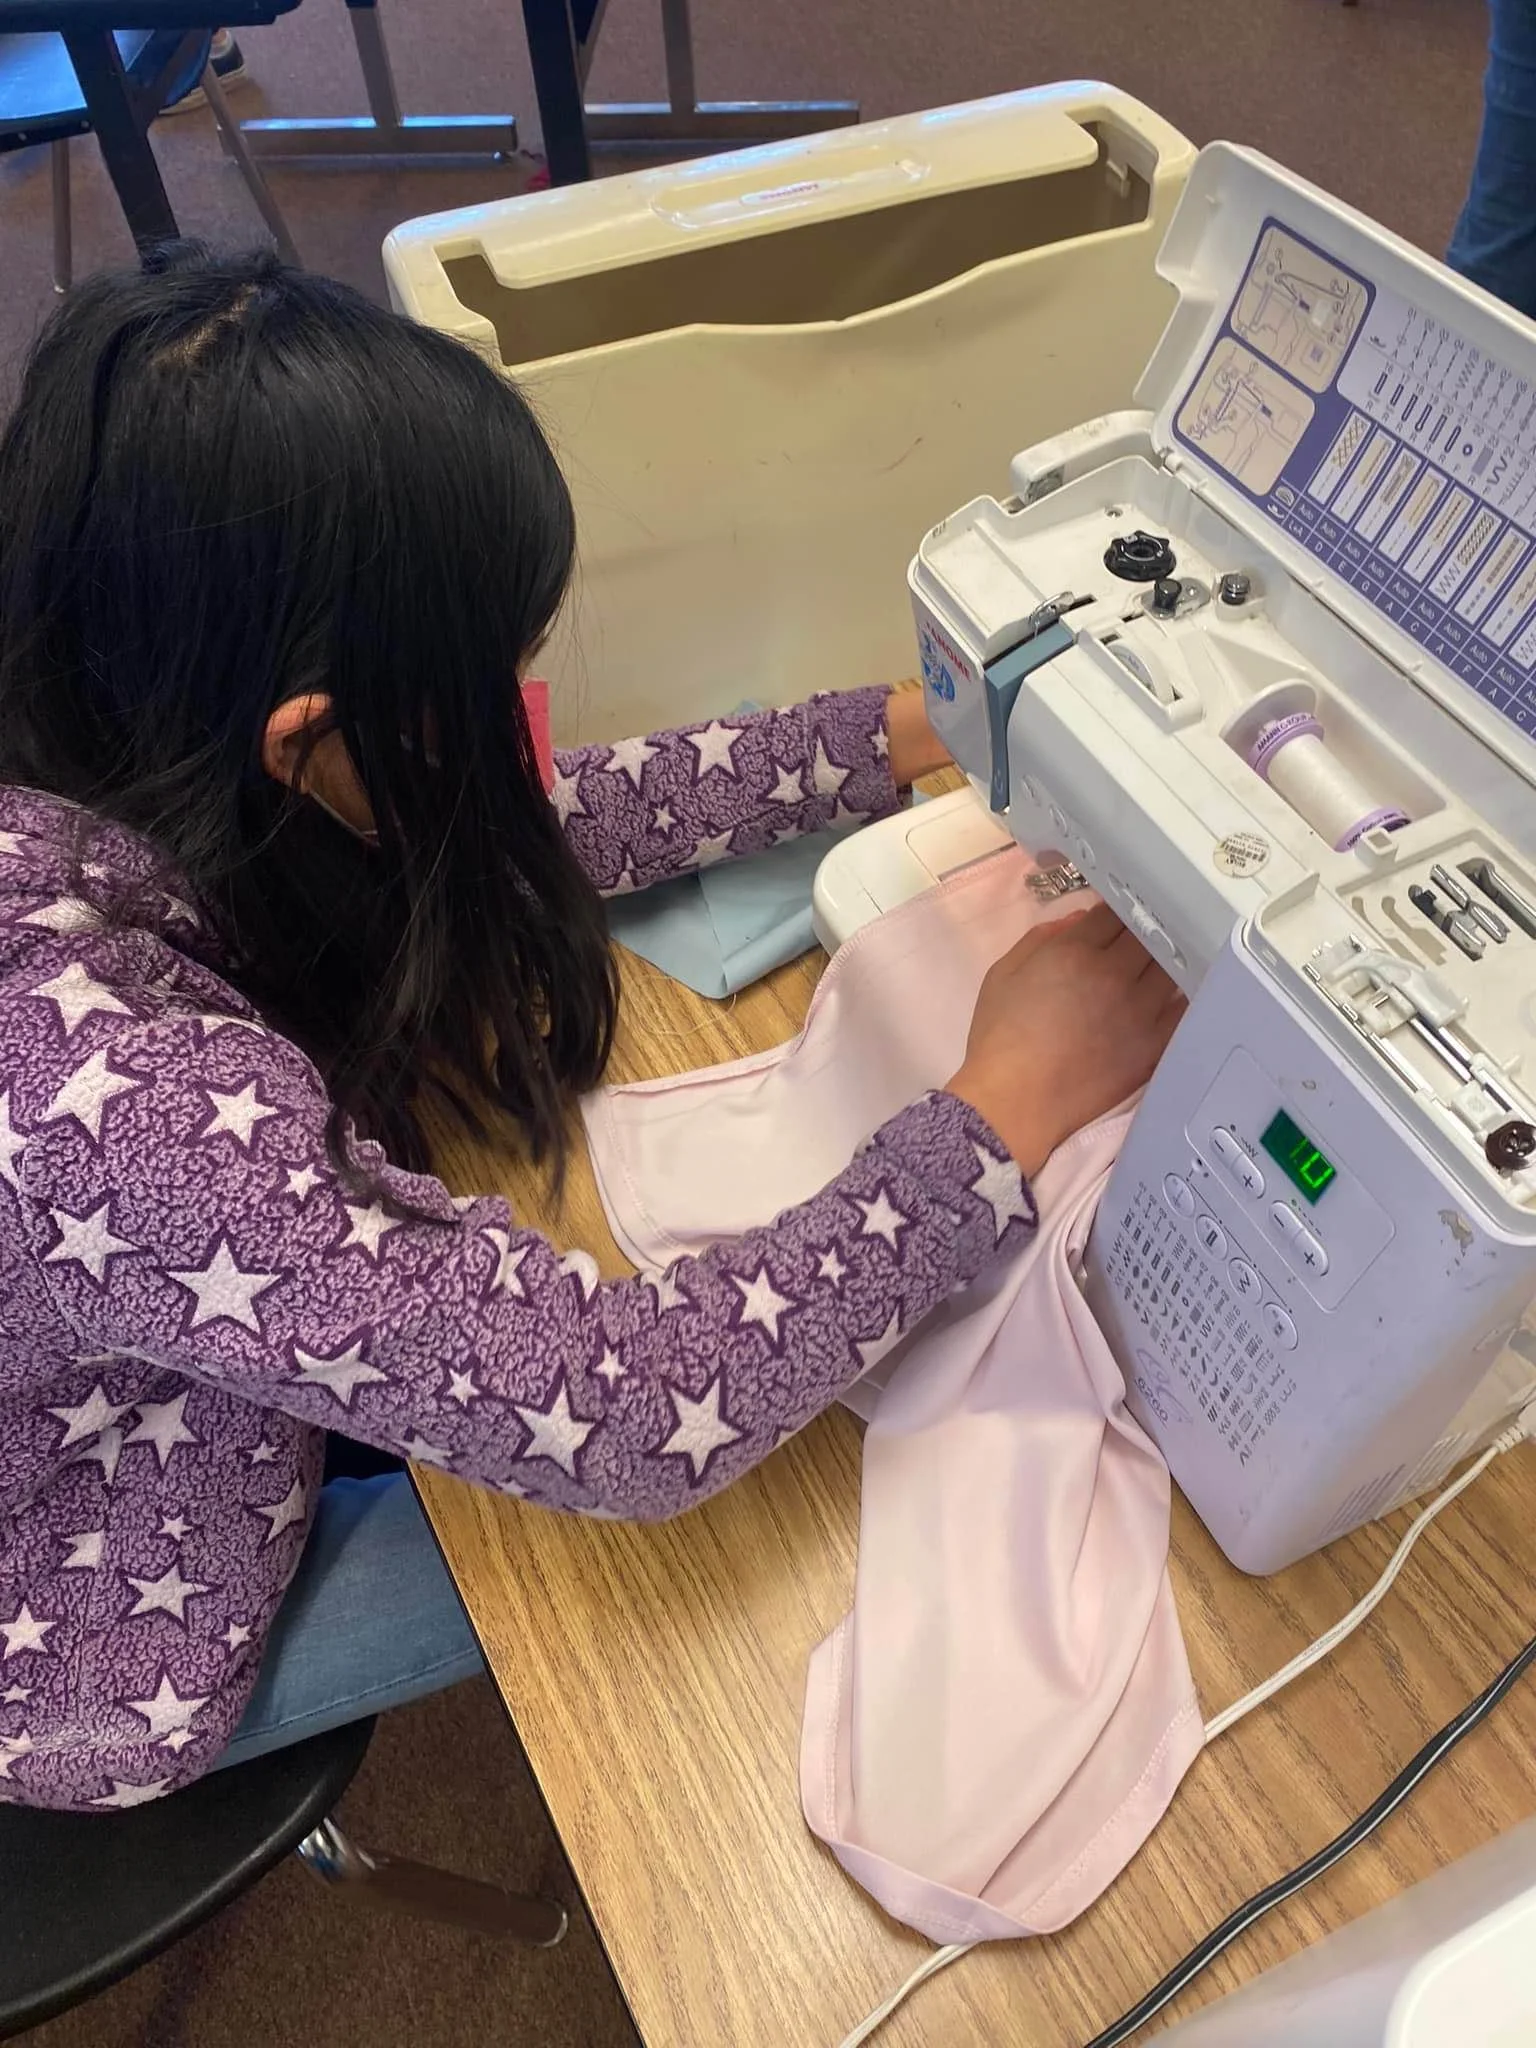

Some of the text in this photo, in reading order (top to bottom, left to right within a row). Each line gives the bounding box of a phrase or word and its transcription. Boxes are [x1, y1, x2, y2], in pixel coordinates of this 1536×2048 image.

[1321, 522, 1336, 539] Auto
[1344, 541, 1360, 559] Auto
[1368, 561, 1385, 578] Auto
[1392, 582, 1410, 599] Auto
[1417, 602, 1435, 620] Auto
[1443, 623, 1461, 642] Auto
[1470, 644, 1488, 663] Auto
[1497, 667, 1516, 686] Auto
[1290, 1136, 1334, 1188] 10
